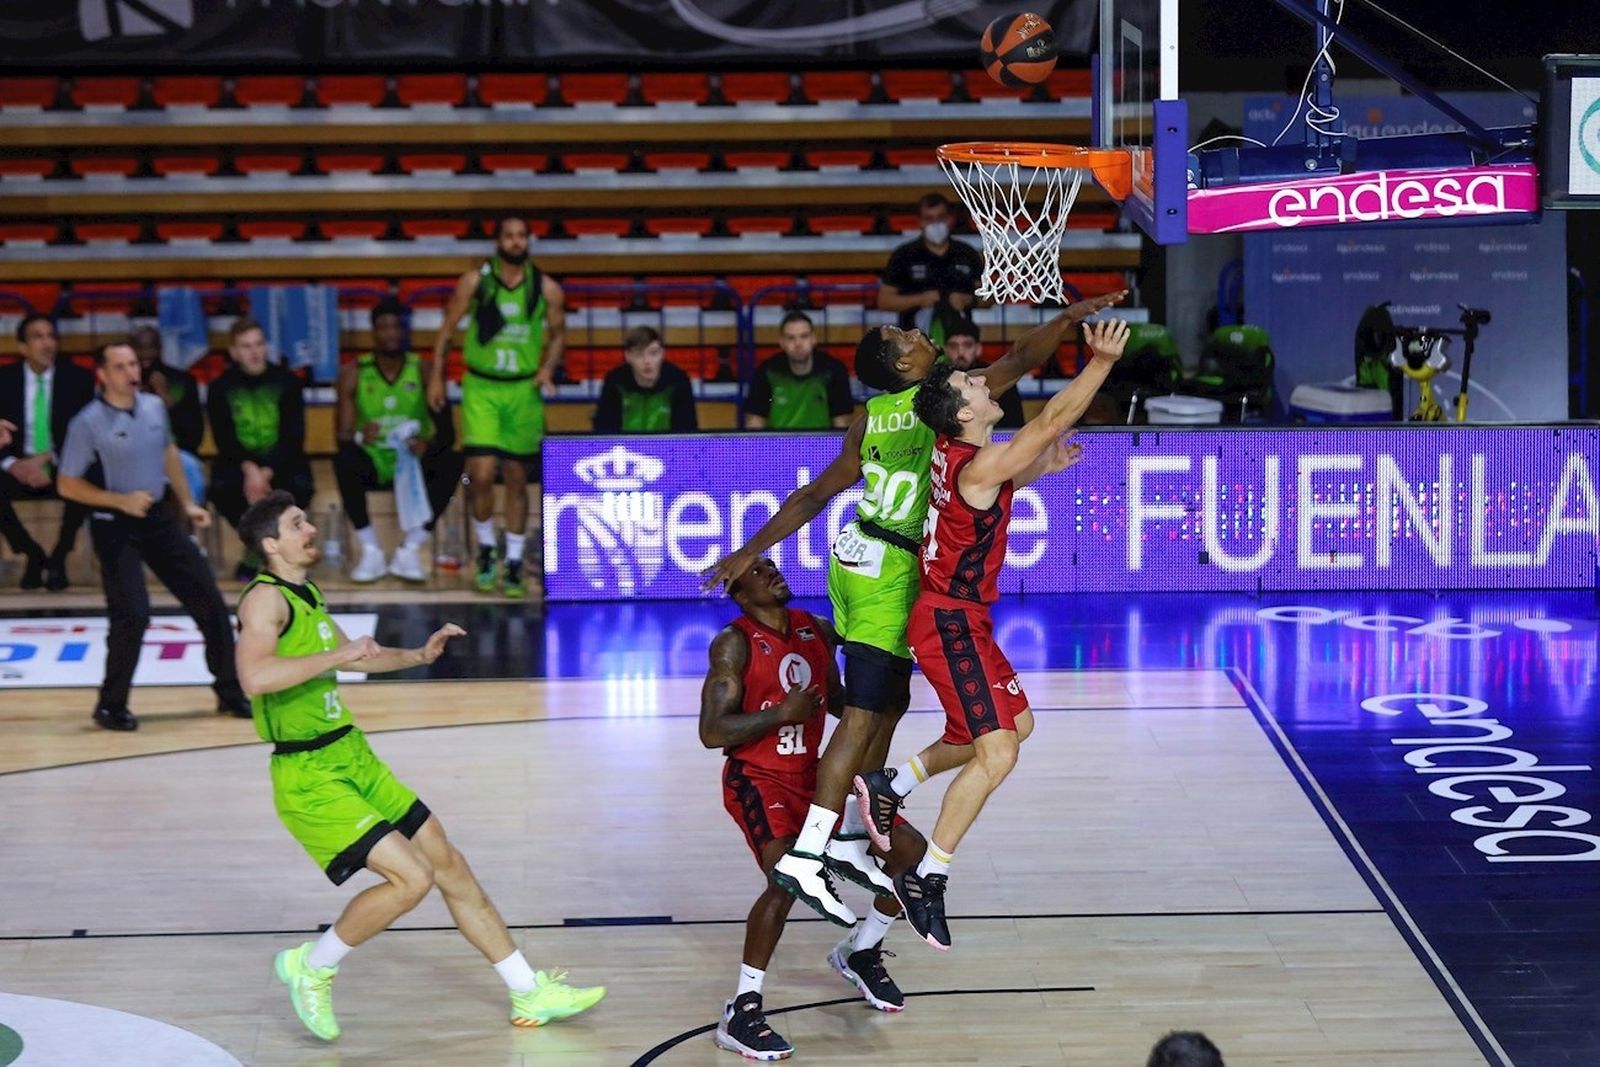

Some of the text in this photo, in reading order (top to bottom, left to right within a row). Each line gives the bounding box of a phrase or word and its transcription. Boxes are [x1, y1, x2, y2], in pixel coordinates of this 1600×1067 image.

[1268, 172, 1505, 227] endesa
[776, 724, 807, 756] 31
[1360, 692, 1600, 863] endesa
